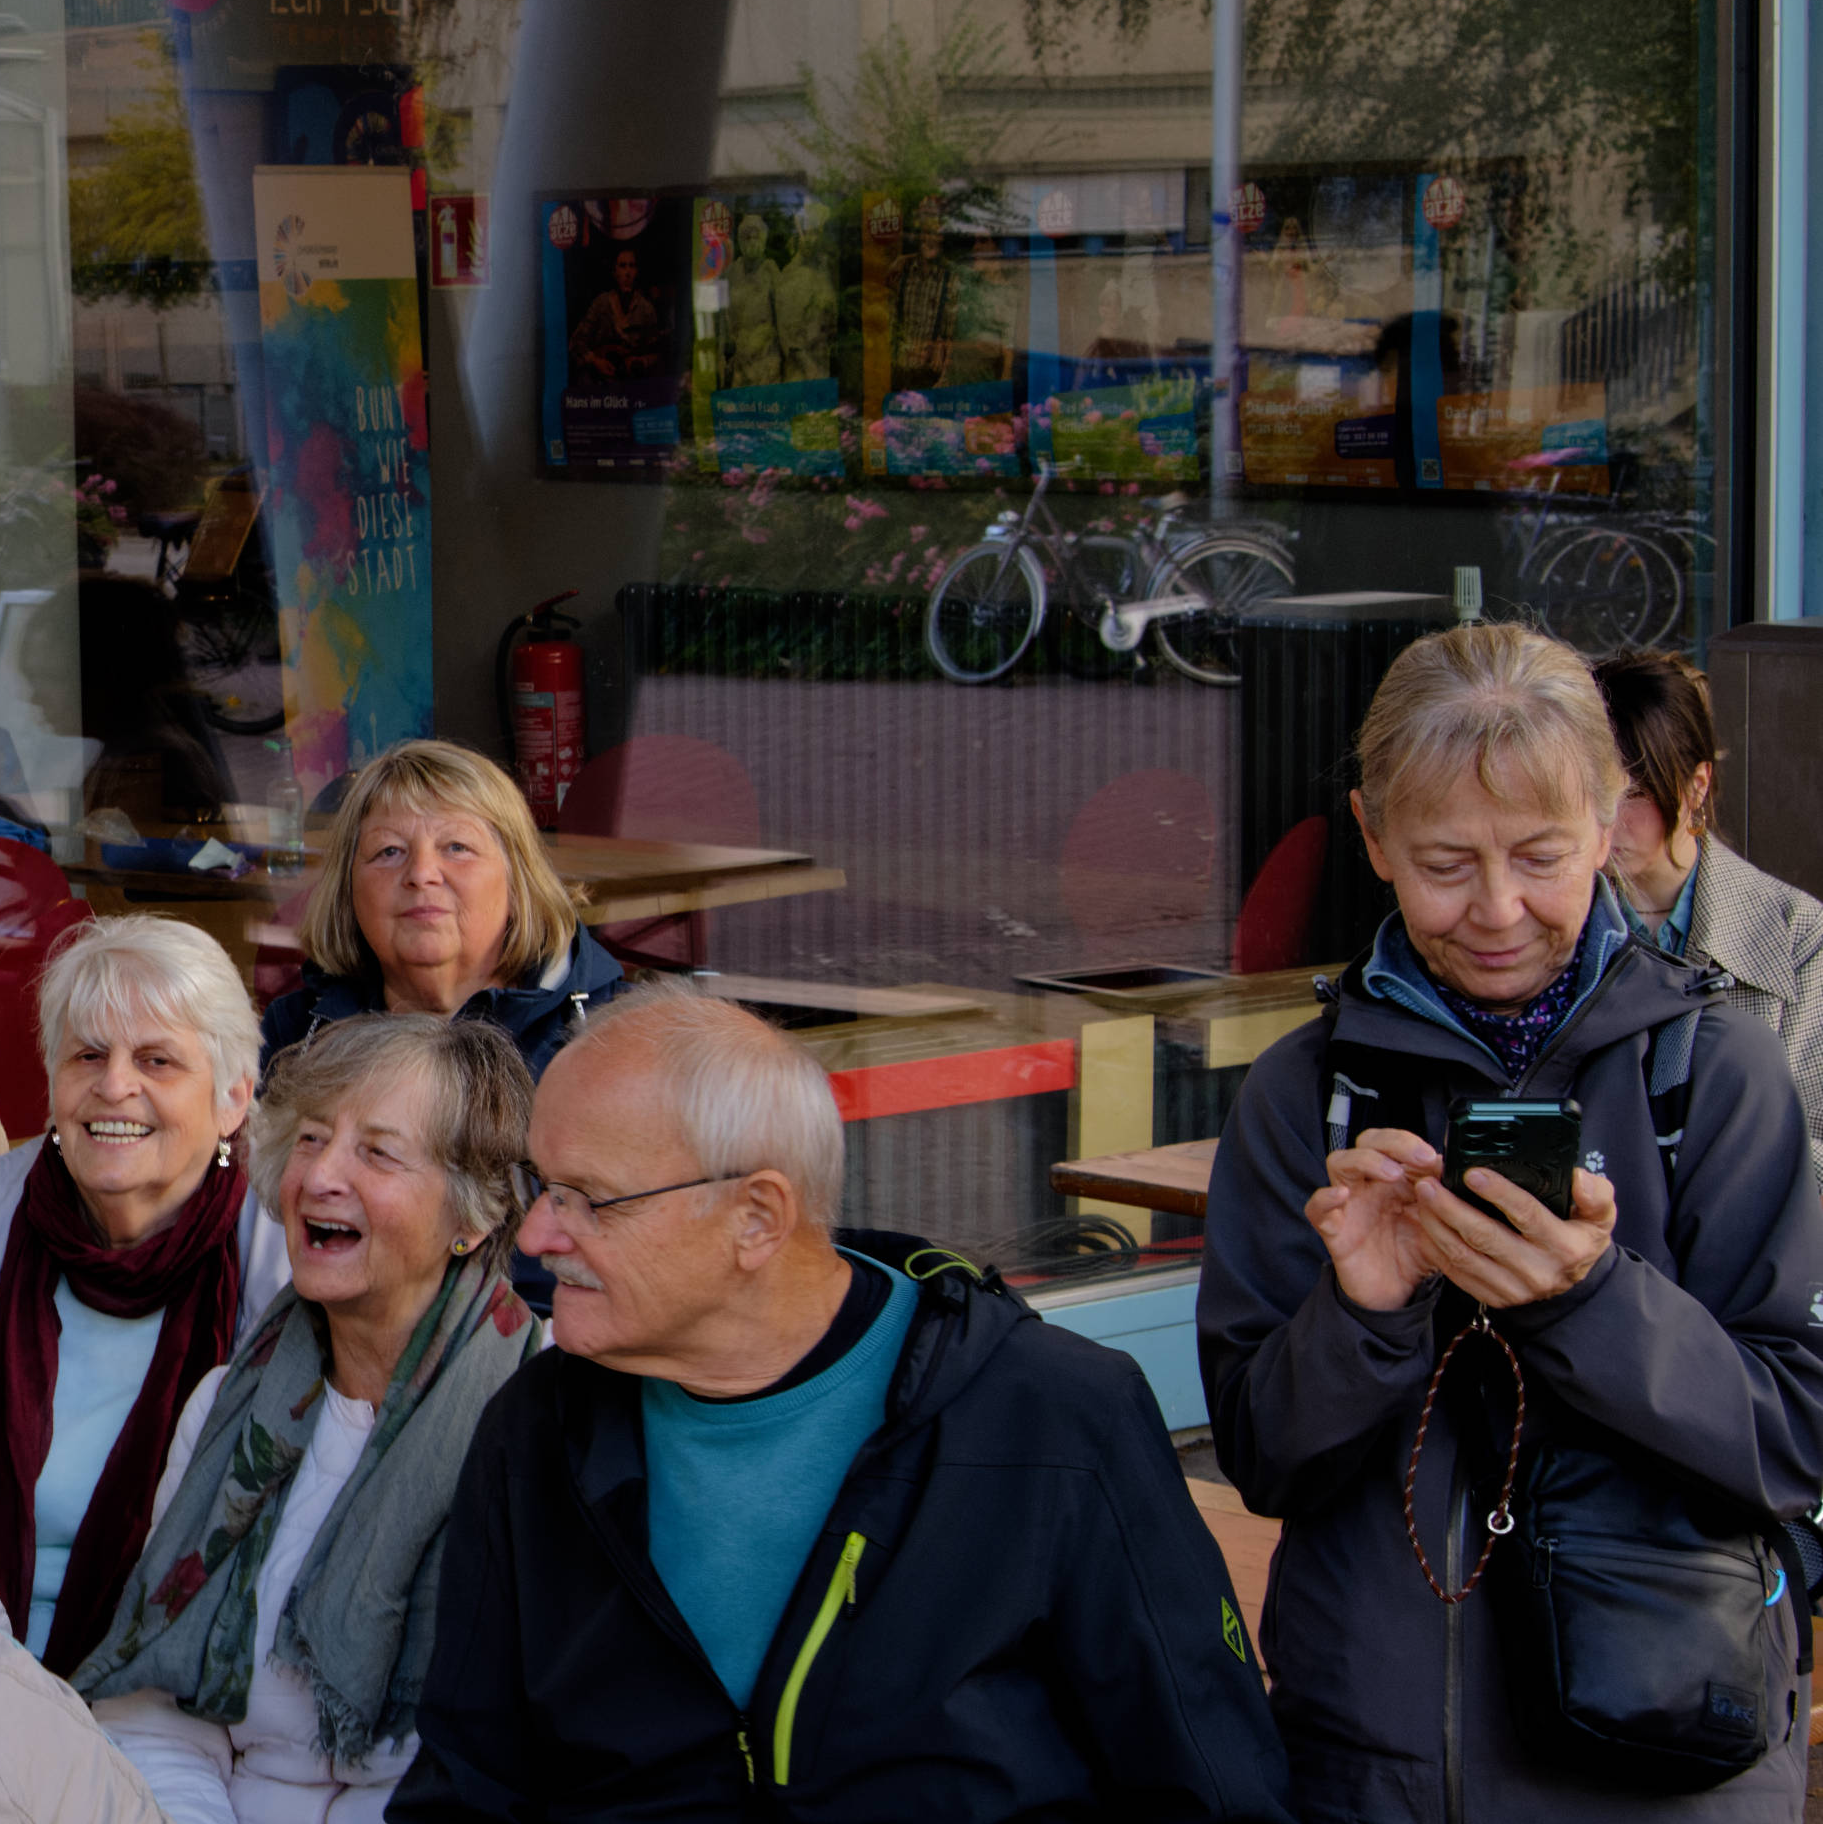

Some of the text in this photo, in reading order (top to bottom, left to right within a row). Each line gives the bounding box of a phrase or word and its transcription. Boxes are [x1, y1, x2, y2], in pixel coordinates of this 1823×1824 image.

[565, 394, 589, 410] Hans
[590, 394, 602, 409] im
[603, 393, 630, 409] Glück
[376, 437, 410, 484] WIE
[356, 490, 415, 540] DIESE
[345, 544, 417, 596] STADT
